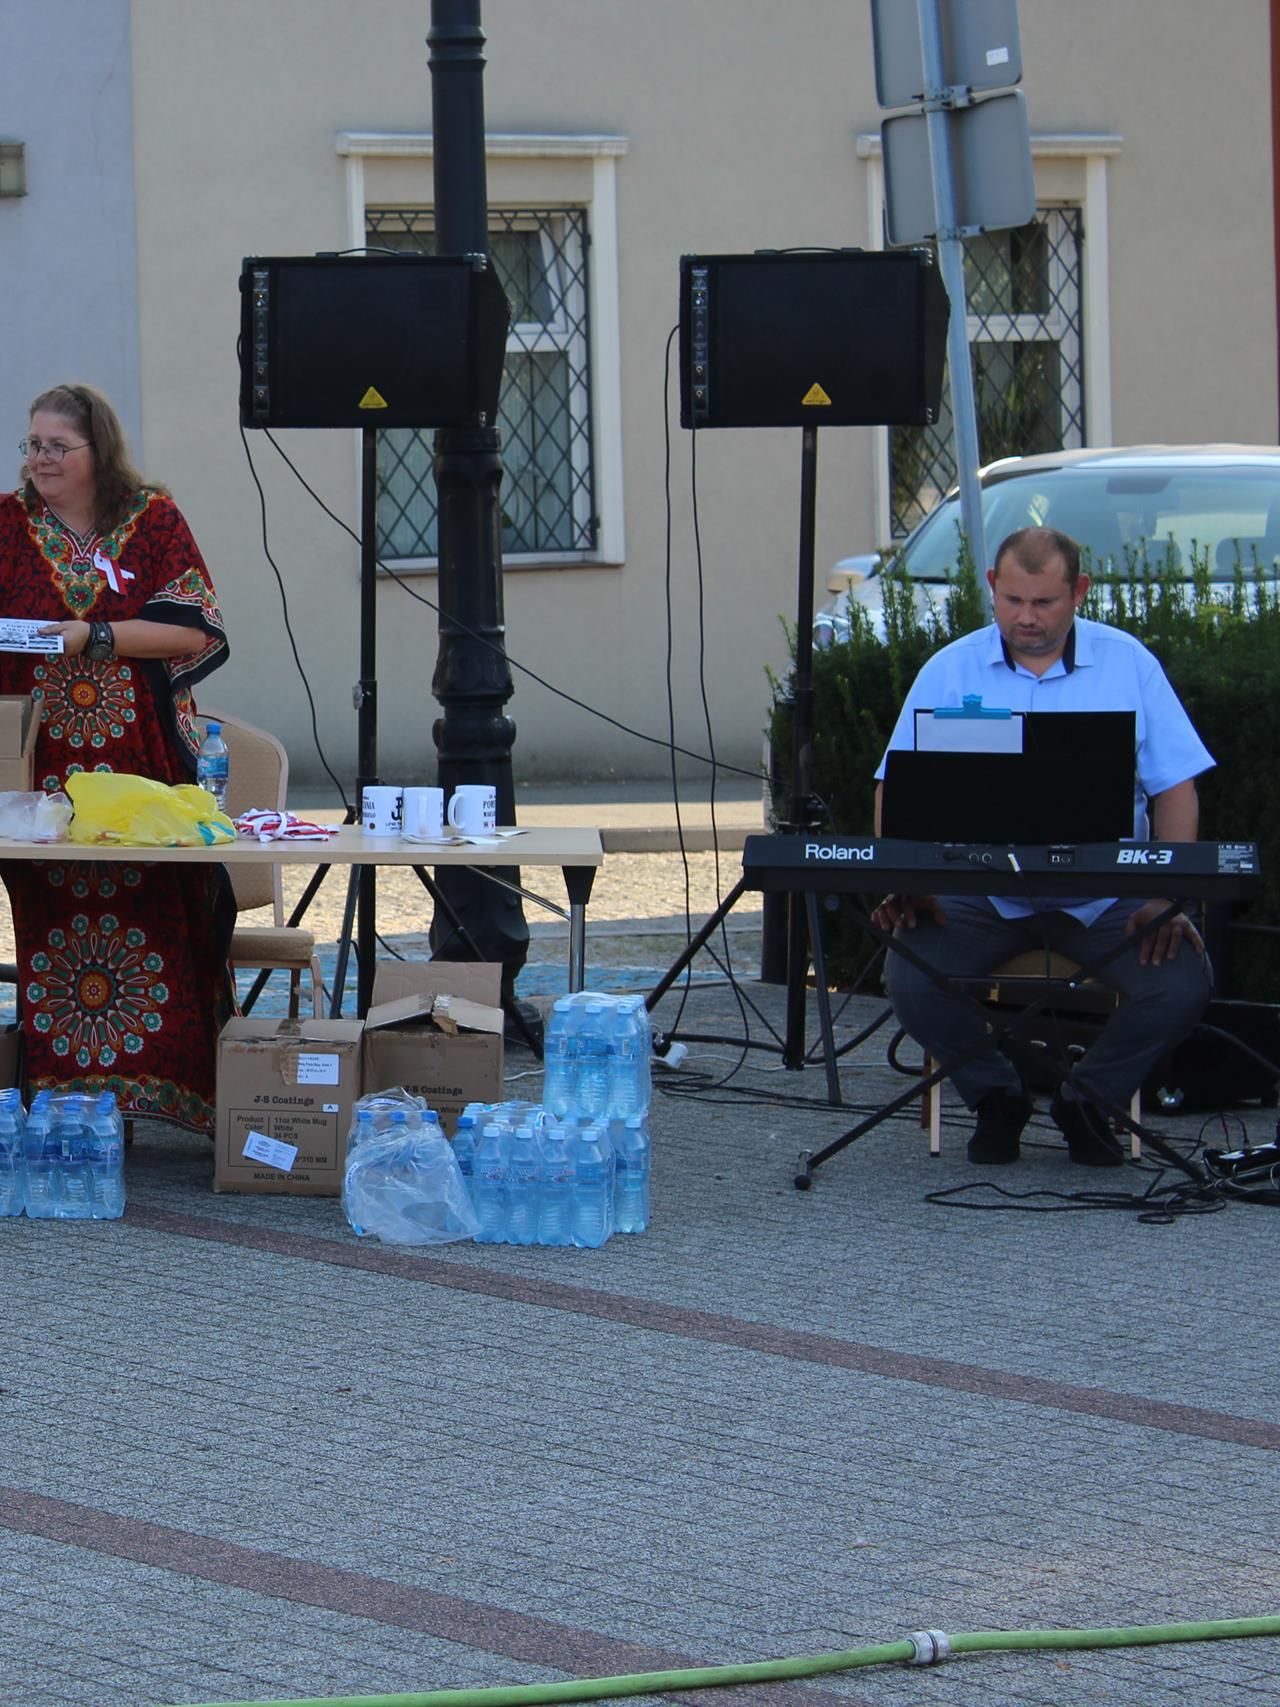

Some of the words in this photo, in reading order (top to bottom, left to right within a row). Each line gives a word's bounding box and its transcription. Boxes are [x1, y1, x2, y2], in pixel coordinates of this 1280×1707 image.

[805, 843, 874, 860] Roland
[1116, 849, 1173, 865] BK-3
[271, 1095, 315, 1106] Coatings
[236, 1114, 264, 1123] Product
[291, 1117, 311, 1125] White
[312, 1118, 327, 1127] Mug
[244, 1123, 264, 1131] Color
[273, 1124, 294, 1132] White
[283, 1132, 298, 1140] PCS
[253, 1173, 276, 1181] MADE
[286, 1174, 311, 1182] CHINA
